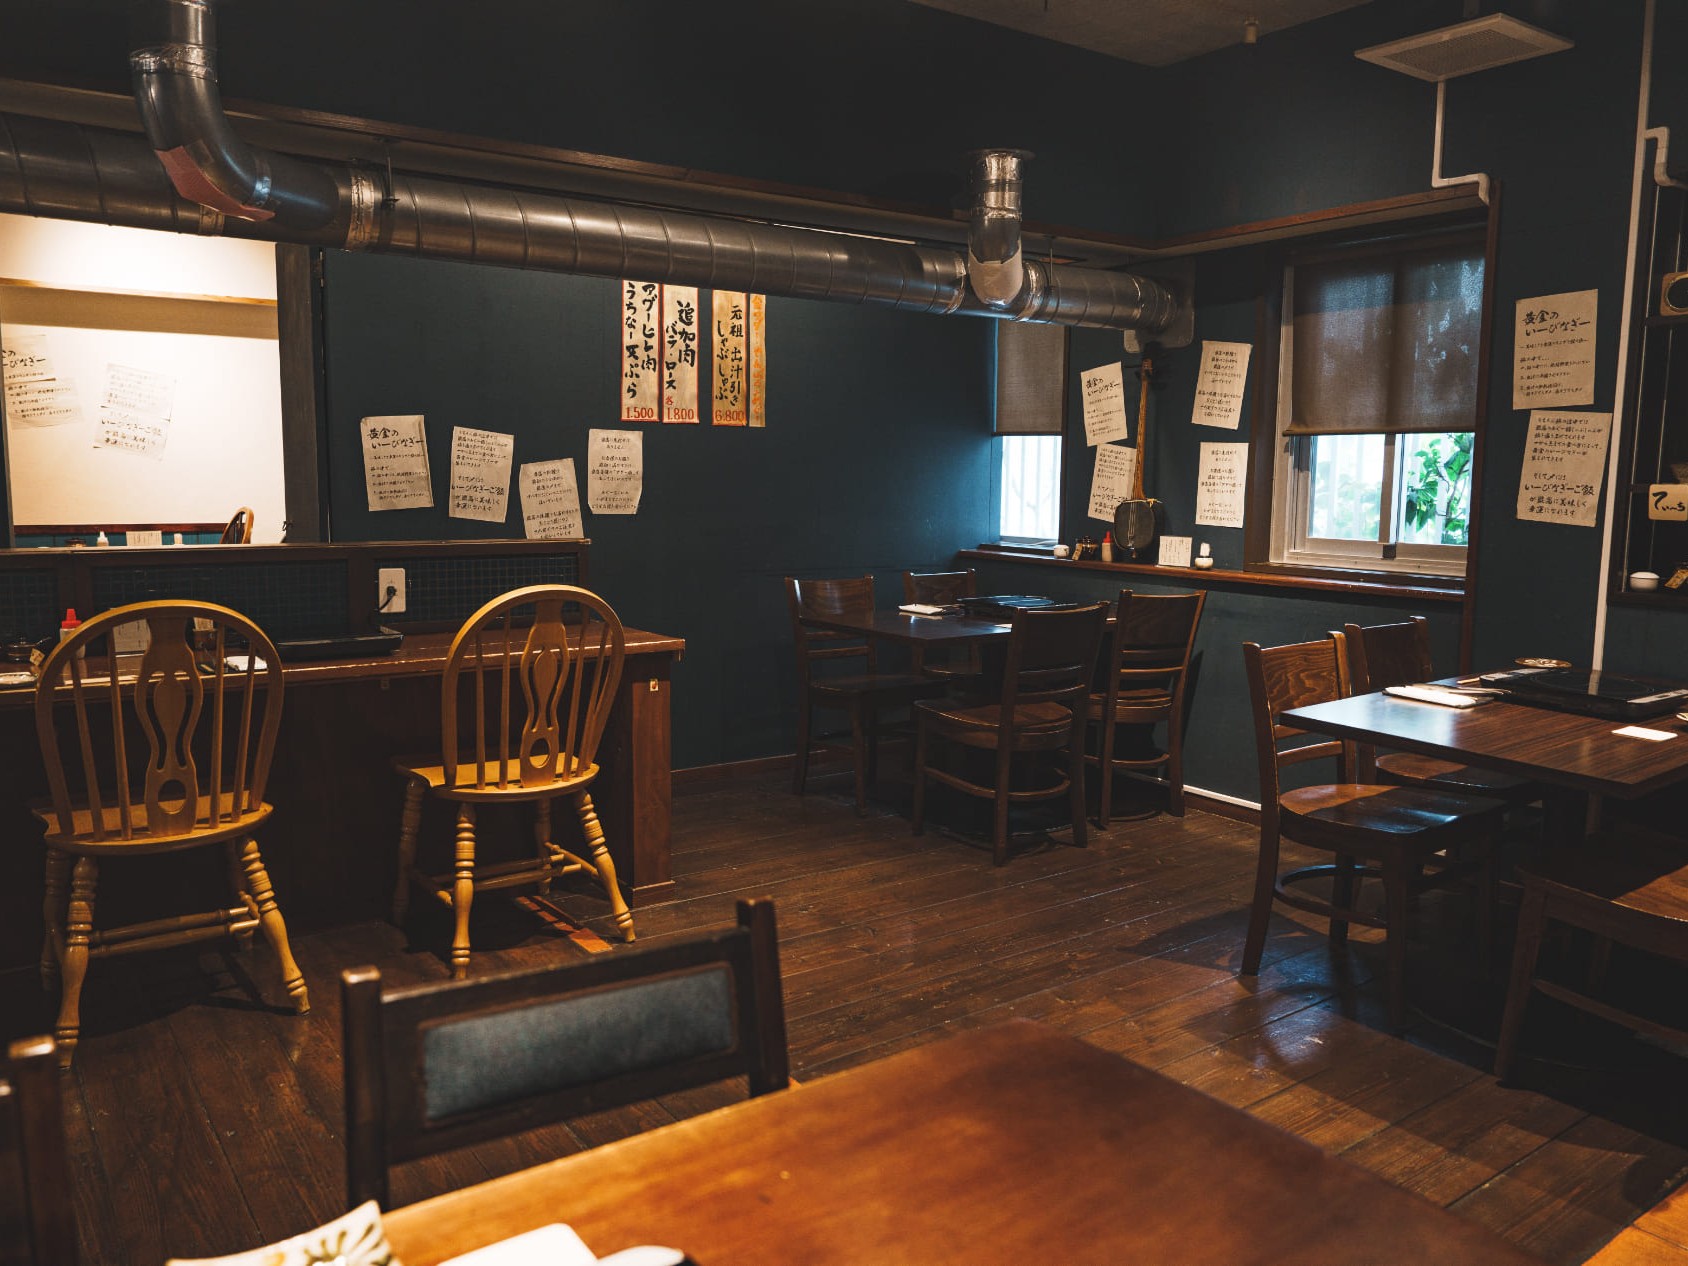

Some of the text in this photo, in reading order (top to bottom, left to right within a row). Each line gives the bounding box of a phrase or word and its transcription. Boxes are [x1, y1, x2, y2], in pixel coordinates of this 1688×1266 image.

[1522, 310, 1559, 325] 黄金の
[624, 282, 640, 399] うちなー天ぷら
[677, 300, 696, 368] 追加肉
[715, 320, 729, 401] しゃぶしゃぶ
[729, 305, 744, 407] 元祖 出汁引き
[626, 407, 654, 419] 1.500
[667, 407, 694, 420] 1.800
[715, 410, 745, 422] 6.800
[367, 427, 399, 440] 黄金の
